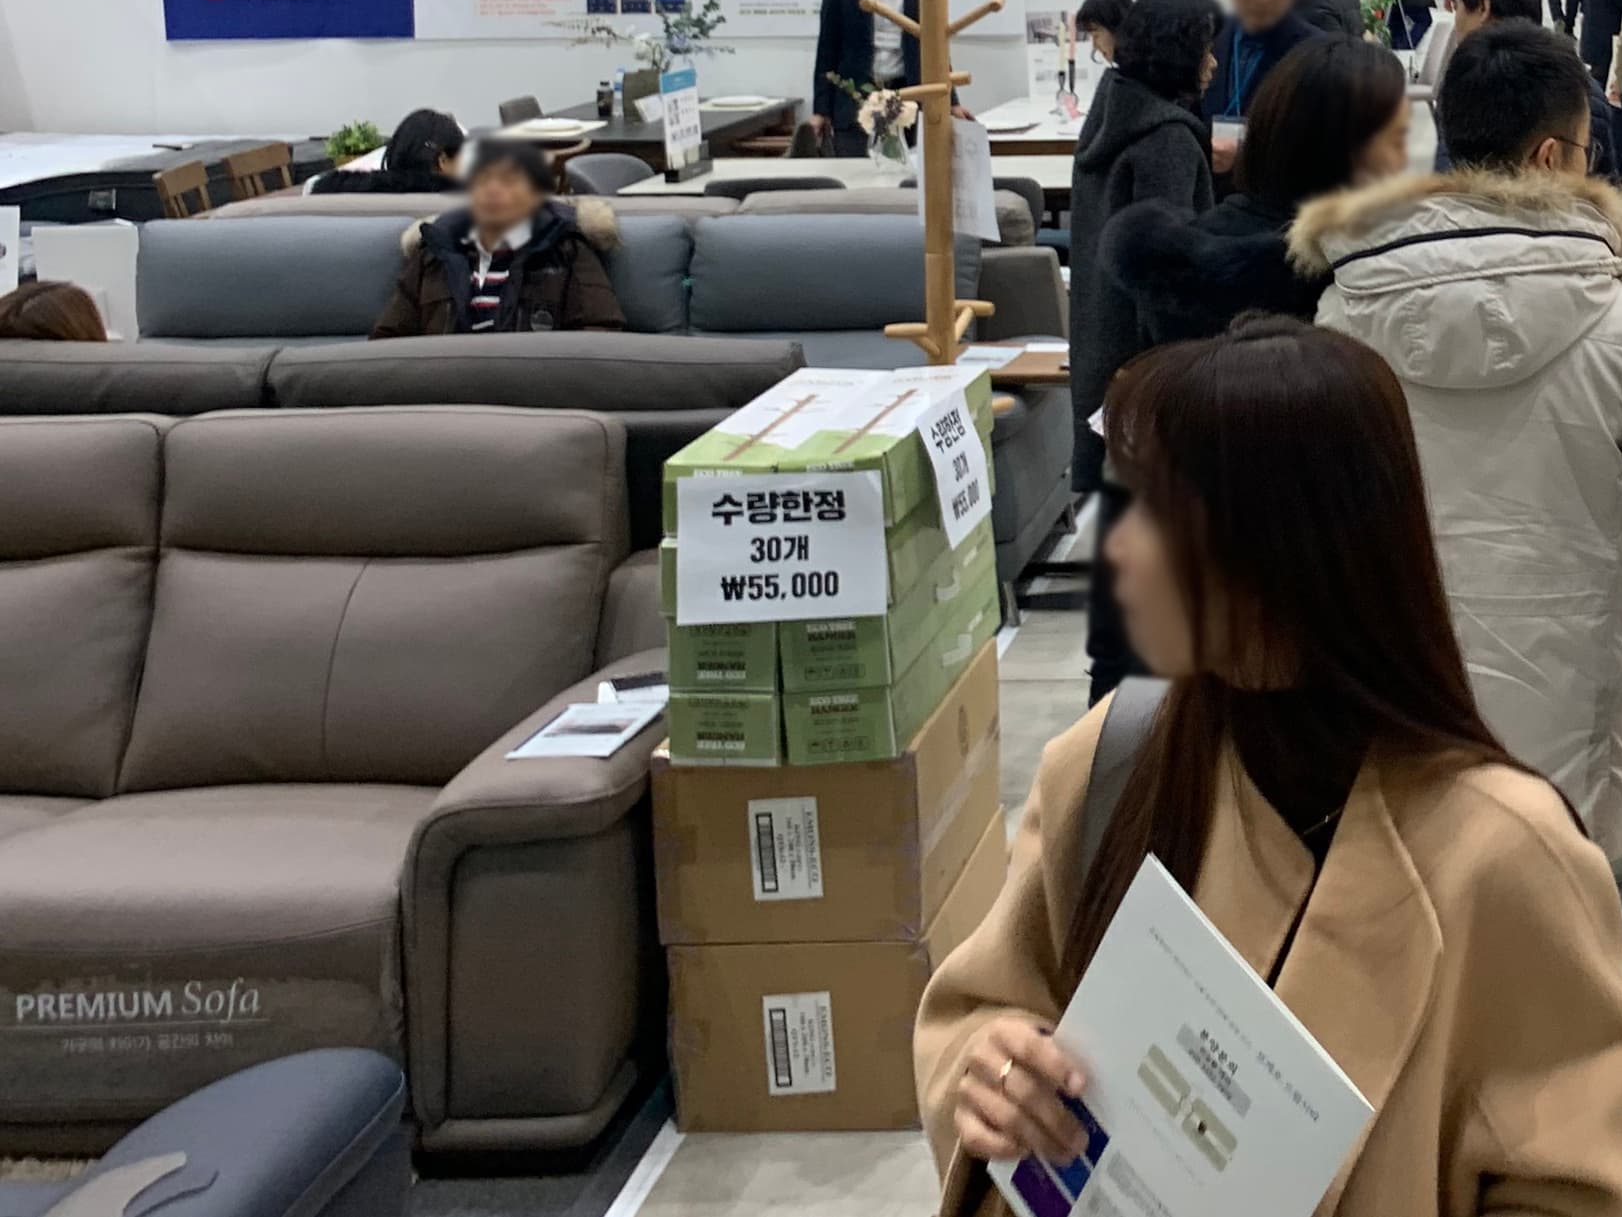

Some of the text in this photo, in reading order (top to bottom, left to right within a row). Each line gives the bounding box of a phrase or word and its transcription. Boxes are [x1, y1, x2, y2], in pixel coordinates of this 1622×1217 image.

[930, 407, 966, 454] 수량한정
[711, 489, 847, 526] 수량한정
[750, 535, 809, 563] 30개
[15, 976, 262, 1024] PREMIUM Sofa
